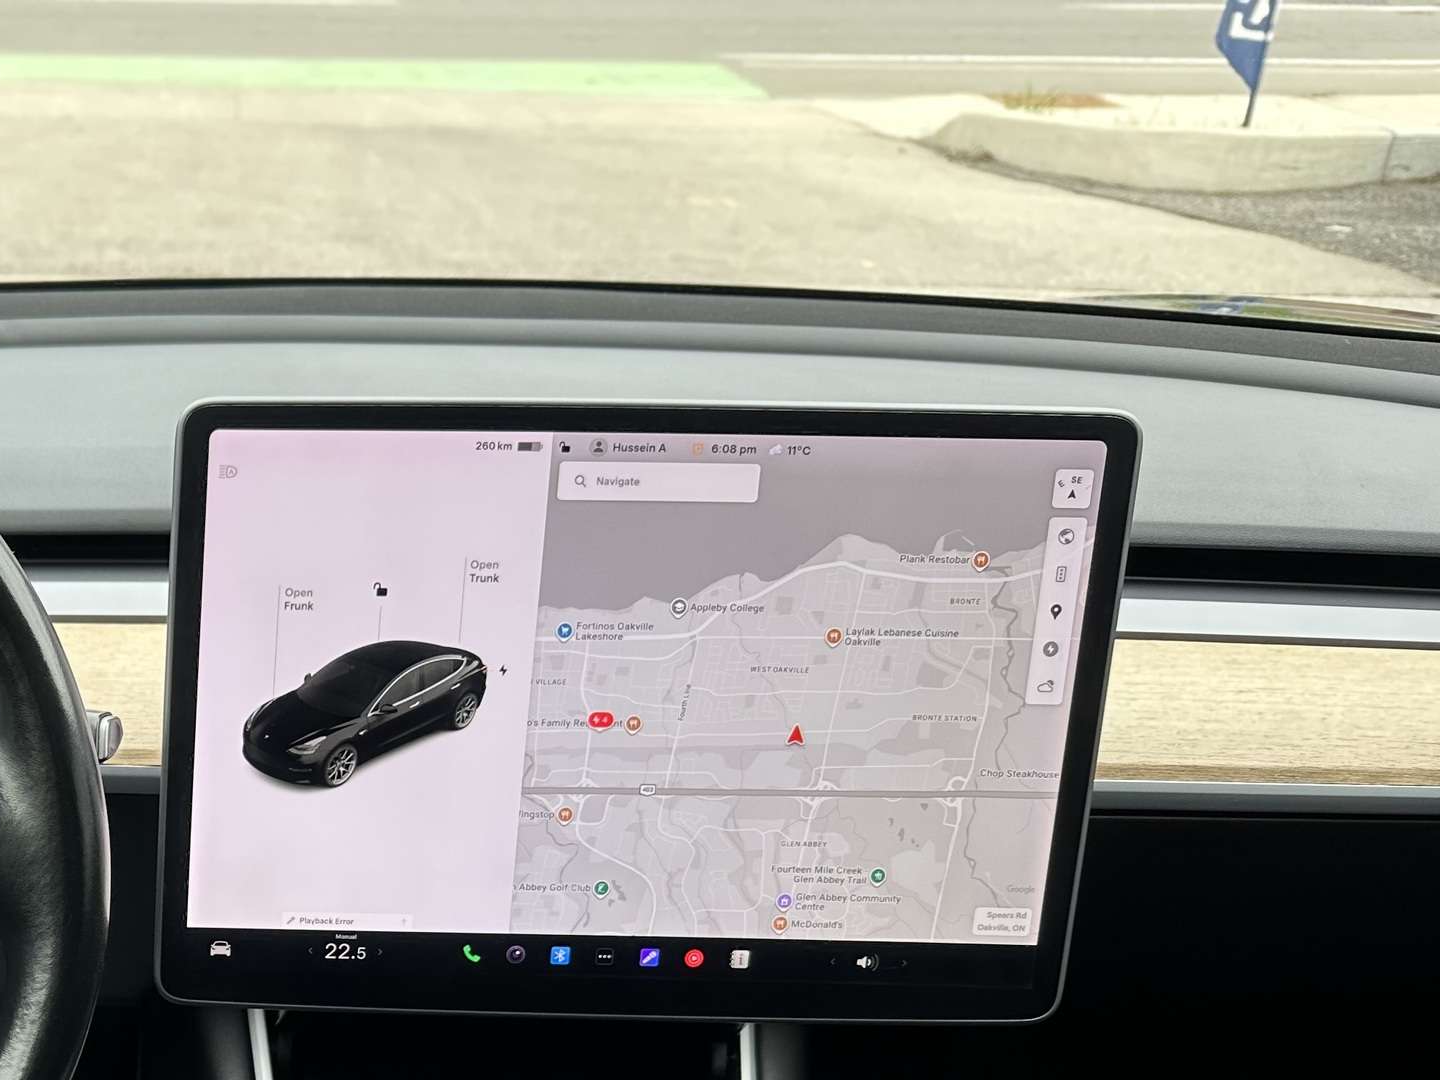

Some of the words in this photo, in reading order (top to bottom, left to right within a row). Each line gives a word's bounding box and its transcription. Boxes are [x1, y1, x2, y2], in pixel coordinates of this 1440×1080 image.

[476, 441, 496, 451] 260
[497, 441, 513, 451] km
[613, 442, 655, 453] Hussein
[657, 443, 667, 453] A
[711, 444, 736, 455] 6:08
[739, 445, 758, 458] pm
[787, 446, 811, 456] 11°C
[596, 476, 640, 487] Navigate
[1071, 476, 1083, 484] SE
[899, 555, 926, 564] Plank
[928, 555, 970, 564] Restobar
[470, 560, 499, 571] Open
[469, 573, 499, 583] Trunk
[284, 588, 313, 599] Open
[284, 601, 314, 611] Frunk
[690, 604, 727, 613] Appleby
[730, 603, 764, 613] College
[576, 622, 614, 631] Fortinos
[617, 622, 654, 631] Oakville
[575, 632, 623, 641] Lakeshore
[878, 628, 922, 638] Lebanese
[924, 629, 959, 638] Cuisine
[844, 638, 881, 647] Oakville
[773, 666, 809, 674] OAKVILLE
[541, 718, 570, 729] Family
[980, 769, 1004, 778] Chop
[771, 865, 812, 874] Fourteen
[814, 866, 834, 875] Mile
[836, 866, 863, 875] Creek
[793, 875, 814, 884] Glen
[816, 875, 845, 886] Abbey
[518, 883, 547, 893] Abbey
[549, 883, 568, 892] Golf
[571, 883, 591, 892] Club
[796, 893, 817, 901] Glen
[819, 893, 847, 904] Abbey
[849, 894, 902, 905] Community
[795, 902, 825, 911] Centre
[299, 917, 333, 926] Playback
[335, 918, 354, 926] Error
[791, 920, 843, 929] McDonald's
[324, 942, 367, 960] 22.5
